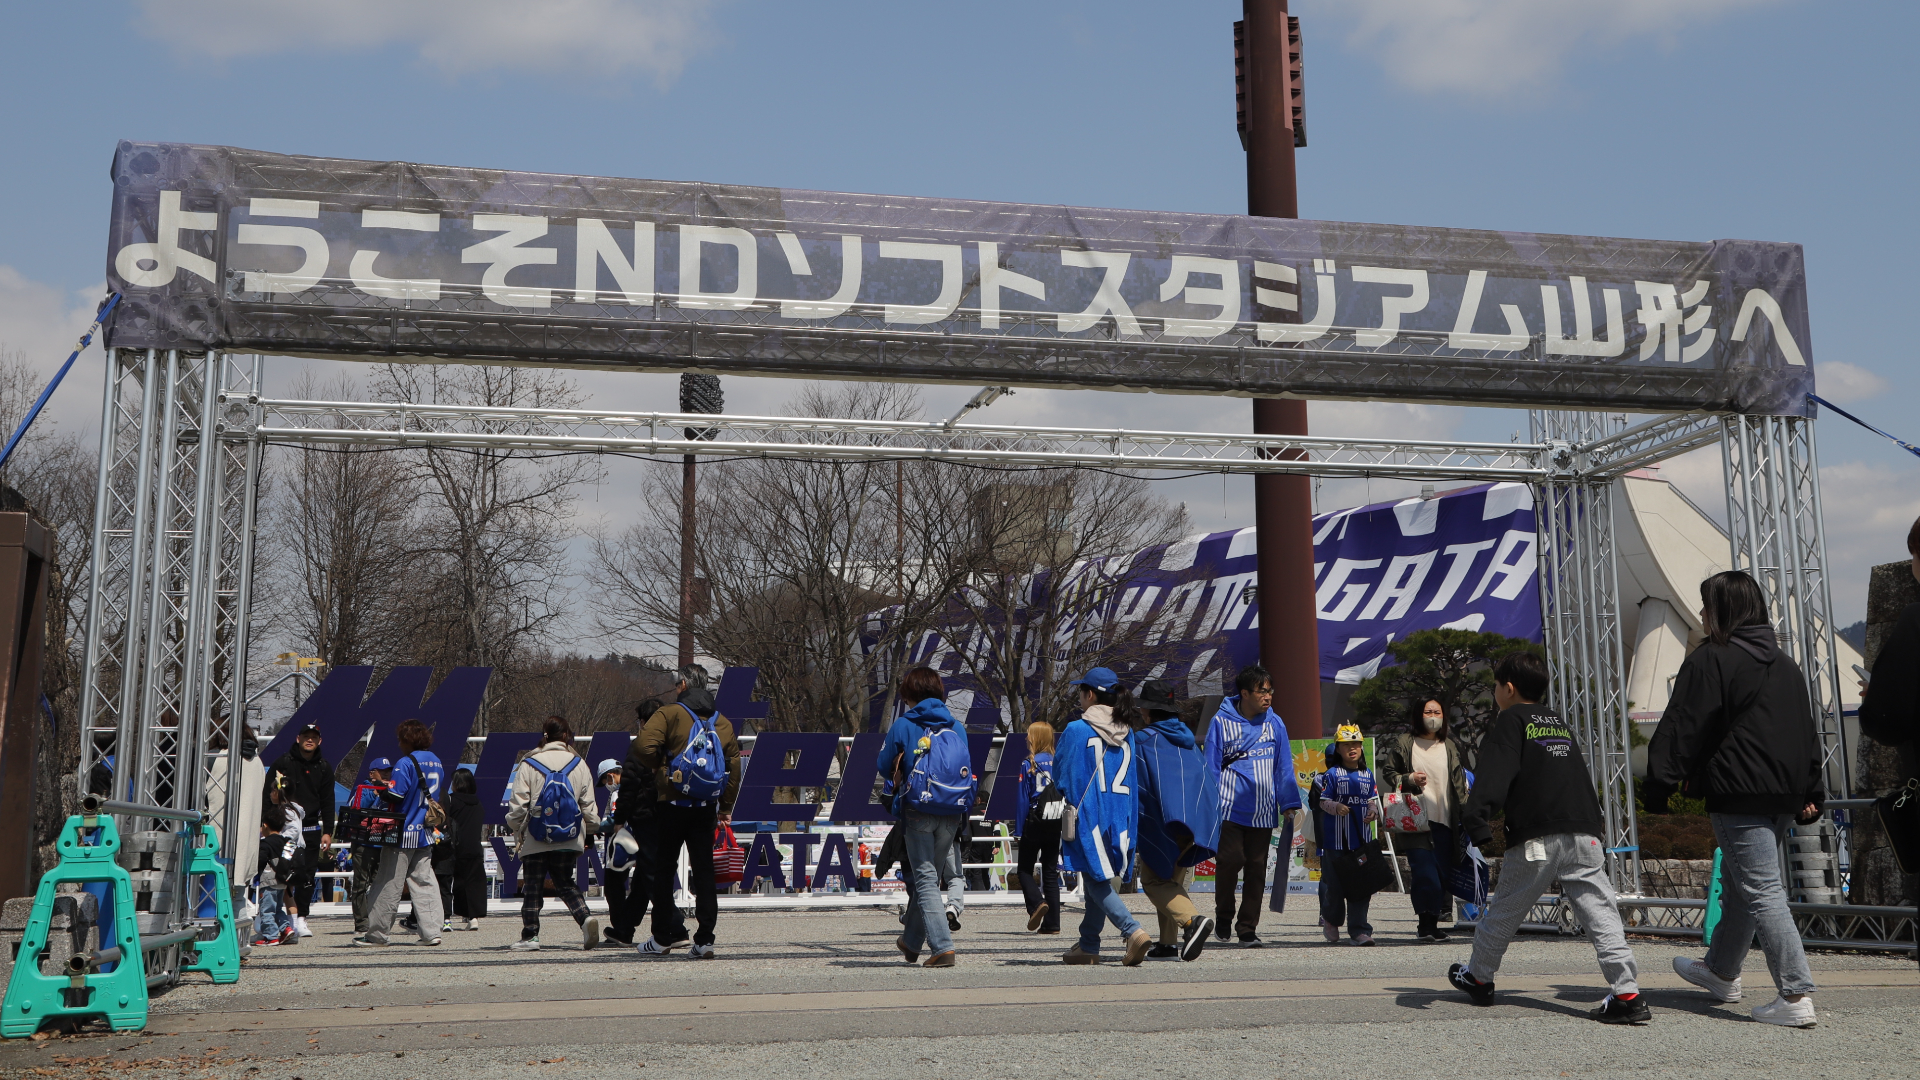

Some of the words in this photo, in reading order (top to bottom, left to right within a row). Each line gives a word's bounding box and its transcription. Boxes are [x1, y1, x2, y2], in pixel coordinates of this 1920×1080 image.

[113, 189, 1807, 367] ようこそNDソフトスタジアム山形へ
[1530, 714, 1562, 726] SKATE
[1546, 744, 1571, 752] QUARTER
[1086, 736, 1132, 796] 12
[1347, 796, 1369, 805] ABea
